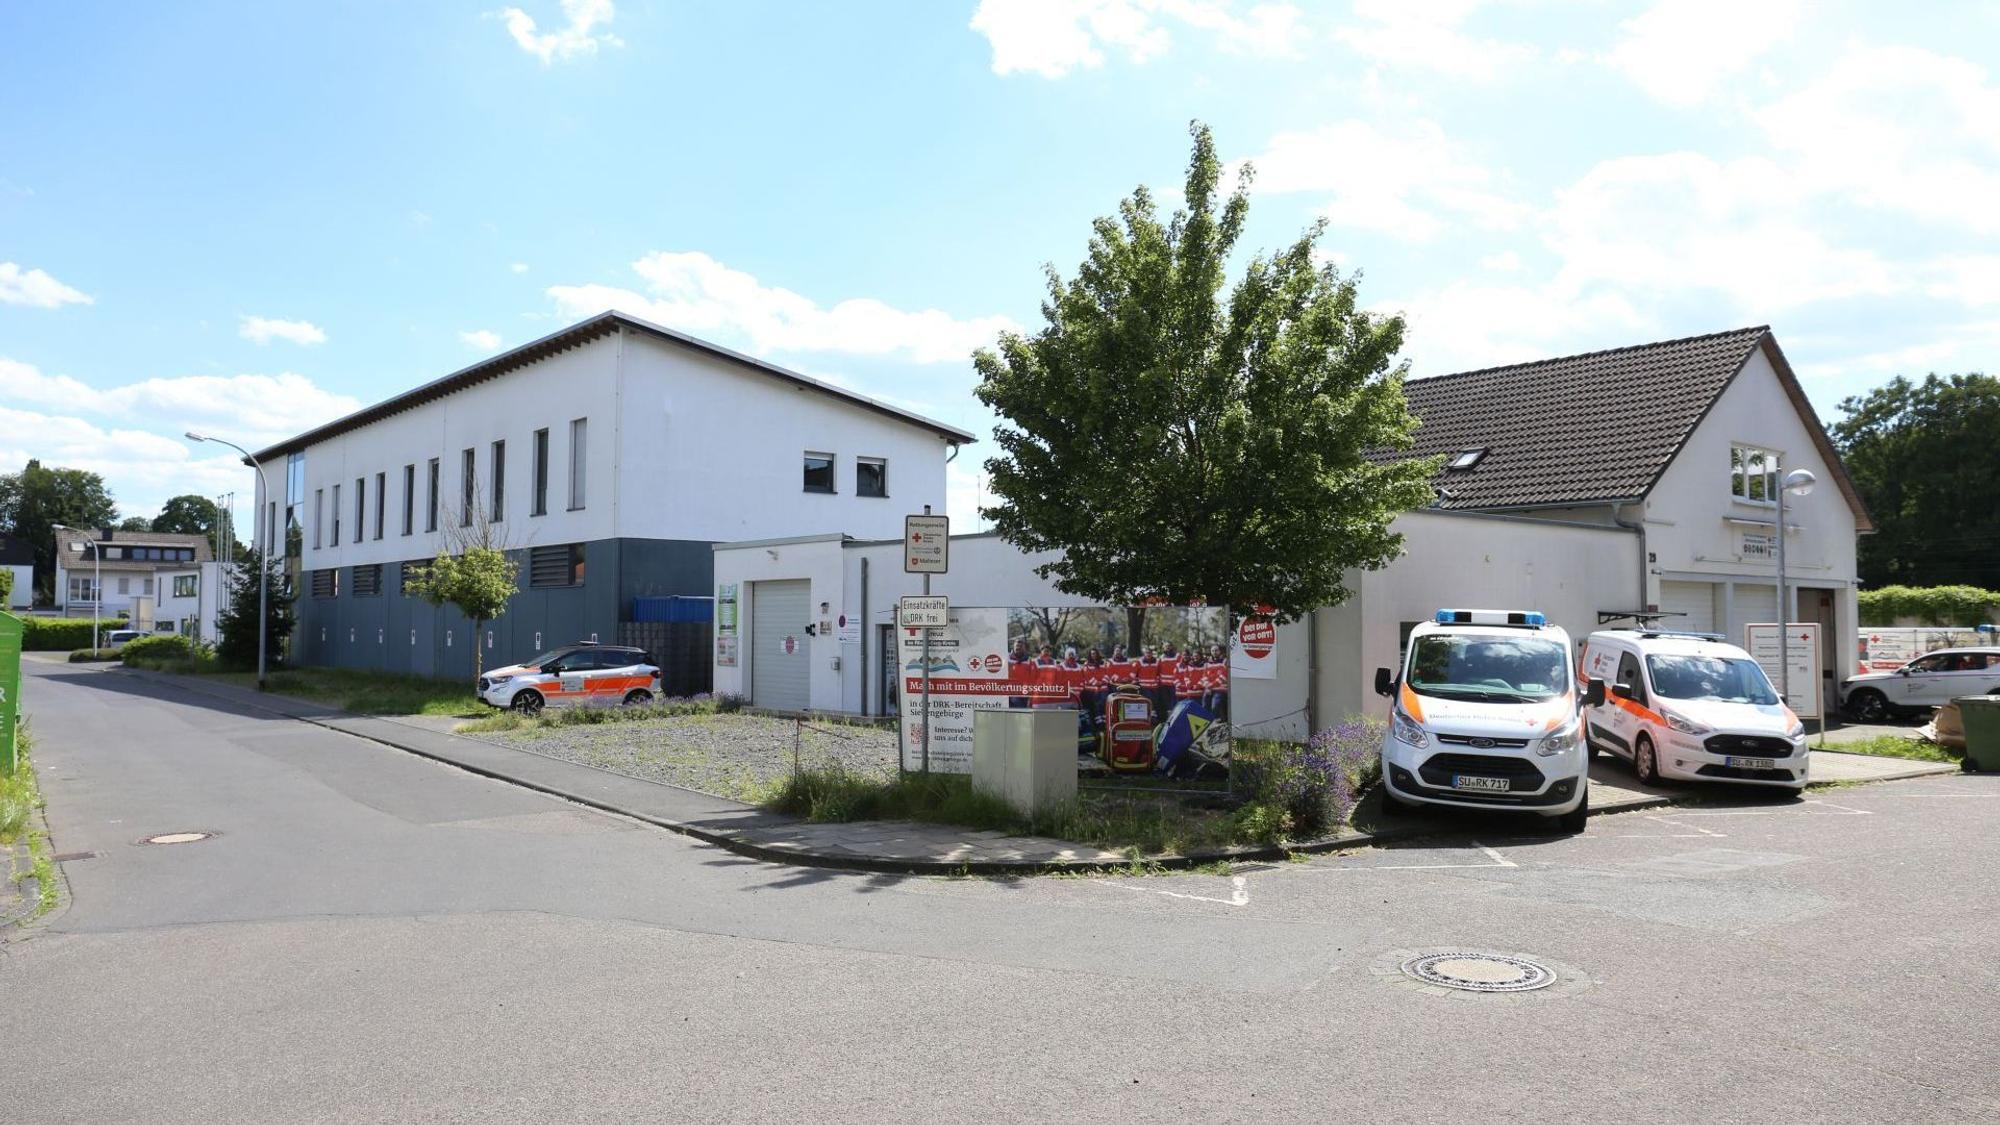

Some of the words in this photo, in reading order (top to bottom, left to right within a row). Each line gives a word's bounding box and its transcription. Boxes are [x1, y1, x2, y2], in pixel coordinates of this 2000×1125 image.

[903, 600, 946, 610] Einsatzkräfte
[910, 613, 923, 622] DRK
[926, 613, 938, 622] frei
[910, 681, 935, 691] Mah
[936, 681, 953, 691] mit
[955, 681, 967, 691] im
[968, 682, 1065, 694] Bevölkerungsschutz
[933, 700, 1002, 710] DRK-Bereitschaft
[934, 726, 967, 734] Interesse?
[947, 734, 958, 742] auf
[1458, 776, 1471, 786] SU
[1475, 778, 1488, 787] RK
[1490, 779, 1508, 789] 717
